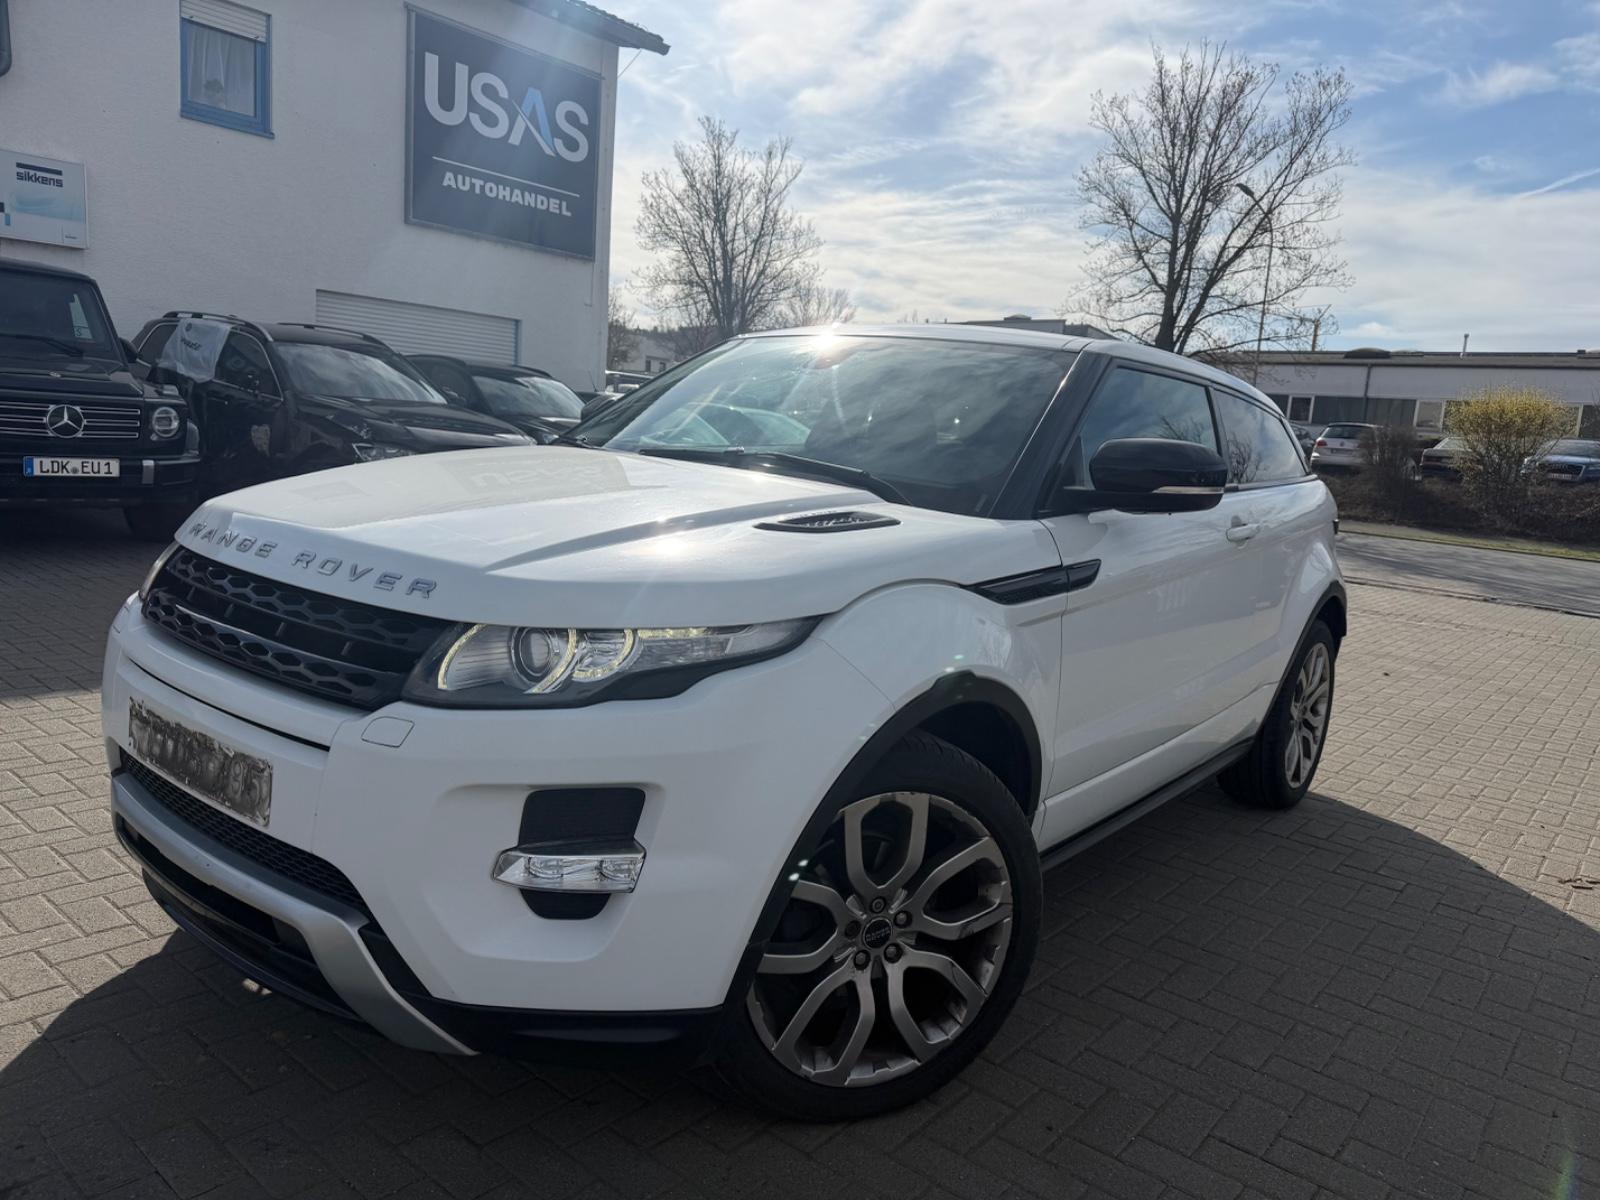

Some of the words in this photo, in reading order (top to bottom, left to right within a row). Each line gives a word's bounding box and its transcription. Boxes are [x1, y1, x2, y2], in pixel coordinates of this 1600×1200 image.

[424, 51, 589, 162] USAS
[16, 171, 63, 188] sikkens
[442, 171, 572, 216] AUTOHANDEL
[39, 460, 70, 474] LDK
[189, 523, 278, 558] RANGE
[291, 550, 438, 599] ROVER
